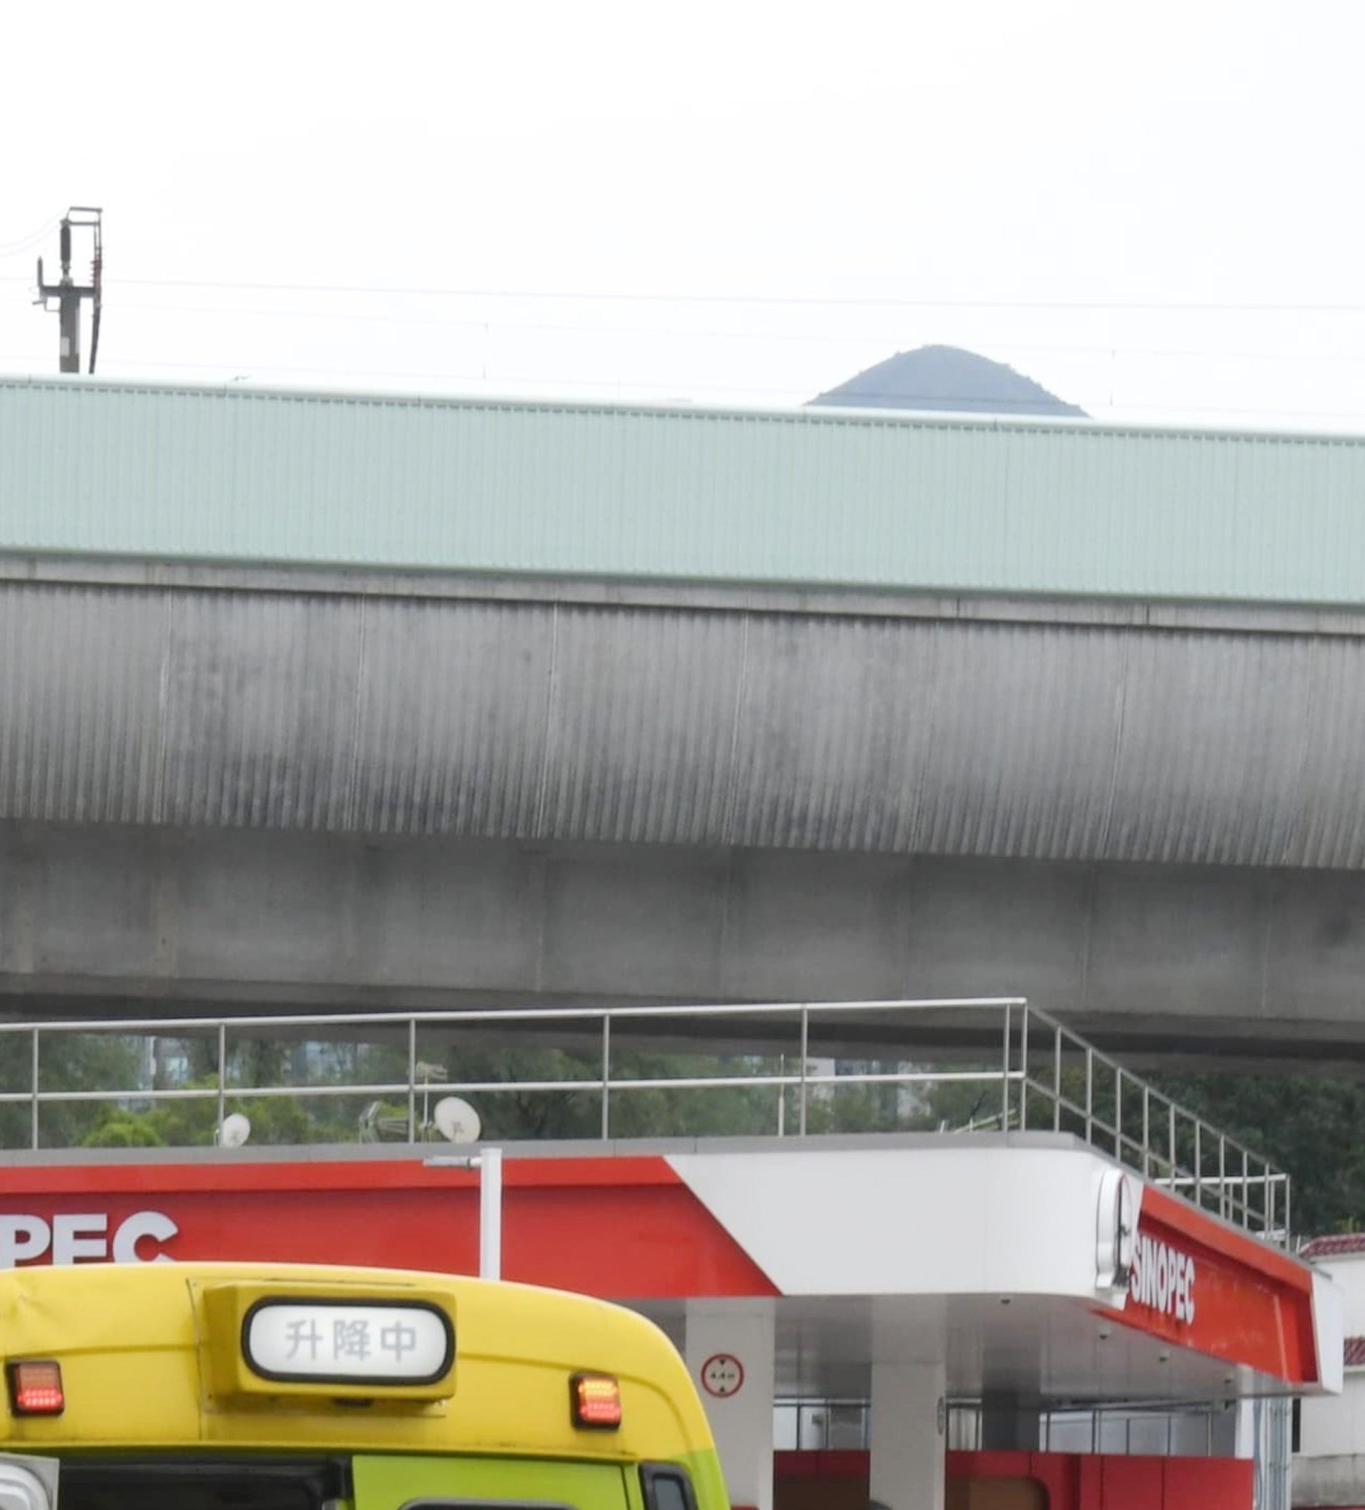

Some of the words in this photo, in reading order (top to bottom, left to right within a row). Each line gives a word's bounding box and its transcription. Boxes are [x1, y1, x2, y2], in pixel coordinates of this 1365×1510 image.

[1130, 1230, 1196, 1326] SINOPEC
[285, 1317, 417, 1362] 升降中
